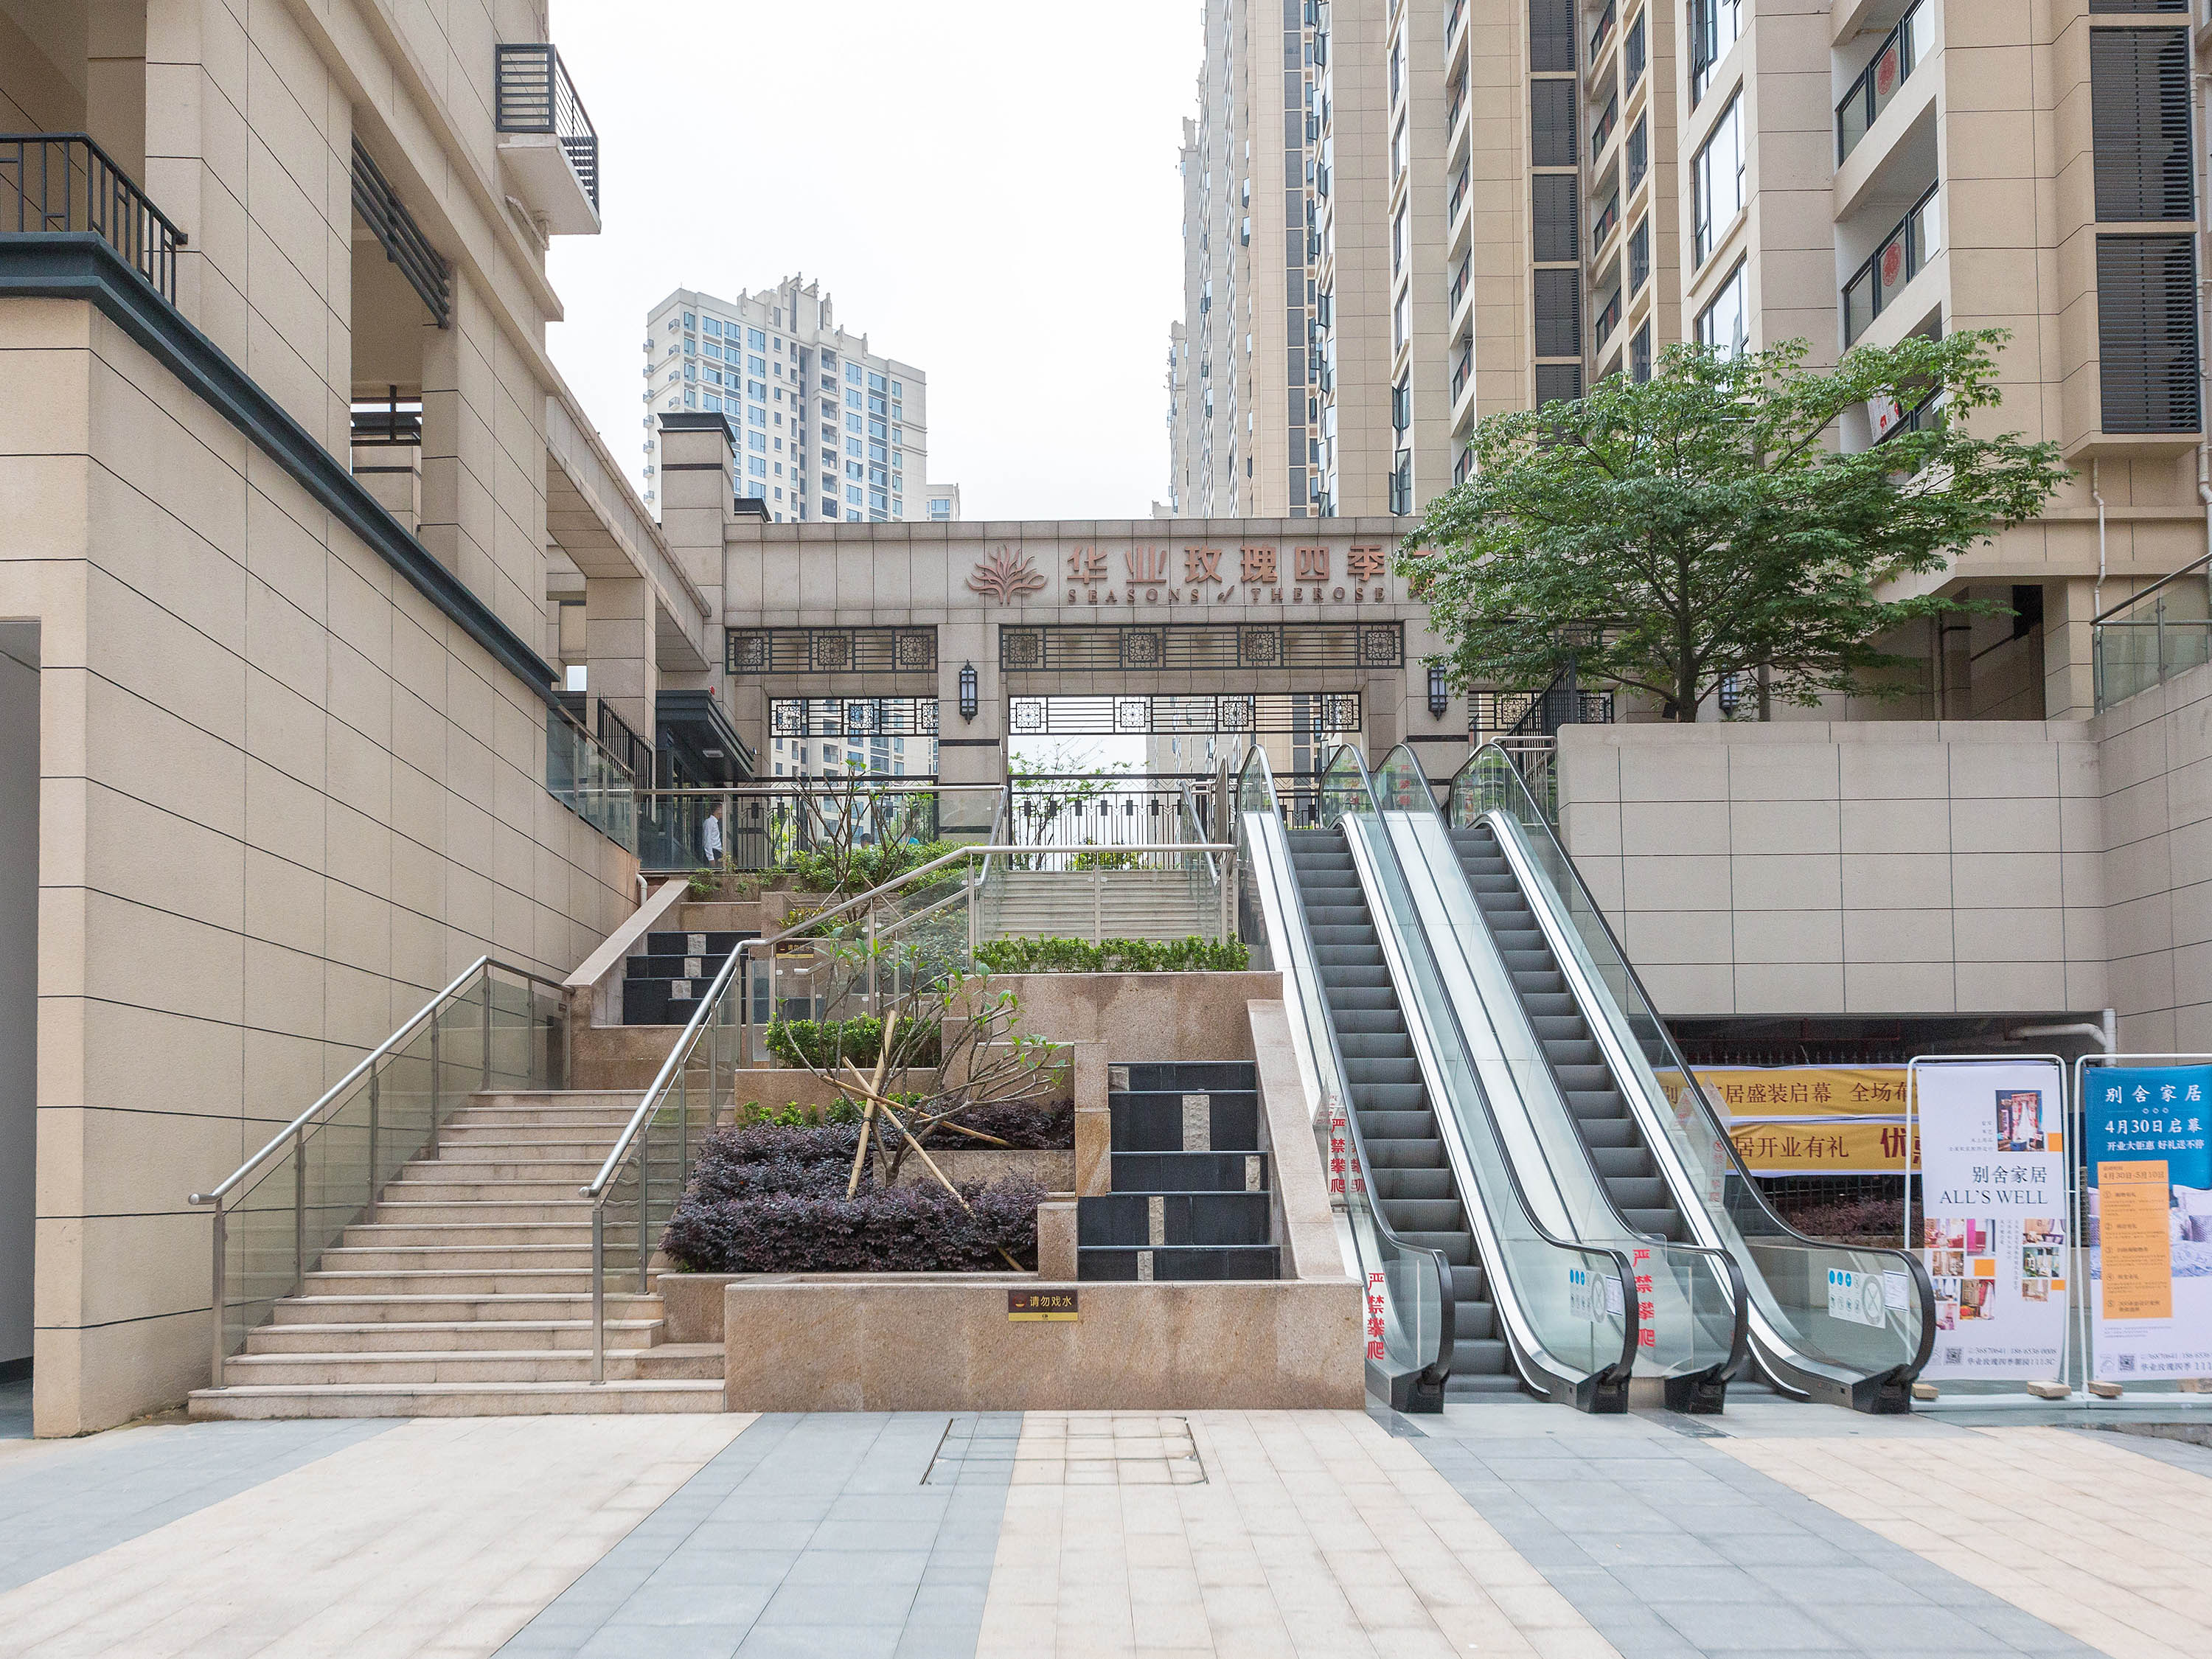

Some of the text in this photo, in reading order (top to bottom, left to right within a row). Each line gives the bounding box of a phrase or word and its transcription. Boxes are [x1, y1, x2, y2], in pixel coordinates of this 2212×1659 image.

[1067, 544, 1385, 584] 华业玫瑰四季
[1068, 588, 1200, 602] SEASONS
[1660, 1082, 1832, 1105] 别居盛装启幕
[2105, 1084, 2202, 1104] 别舍家居
[2105, 1118, 2203, 1135] 4月30日启幕
[1330, 1119, 1346, 1193] 严禁攀爬
[1972, 1165, 2048, 1184] 别舍家居
[1997, 1189, 2048, 1204] WELL
[1030, 1295, 1072, 1307] 请勿戏水
[1632, 1249, 1656, 1348] 严禁攀爬
[1367, 1272, 1385, 1360] 严禁攀爬
